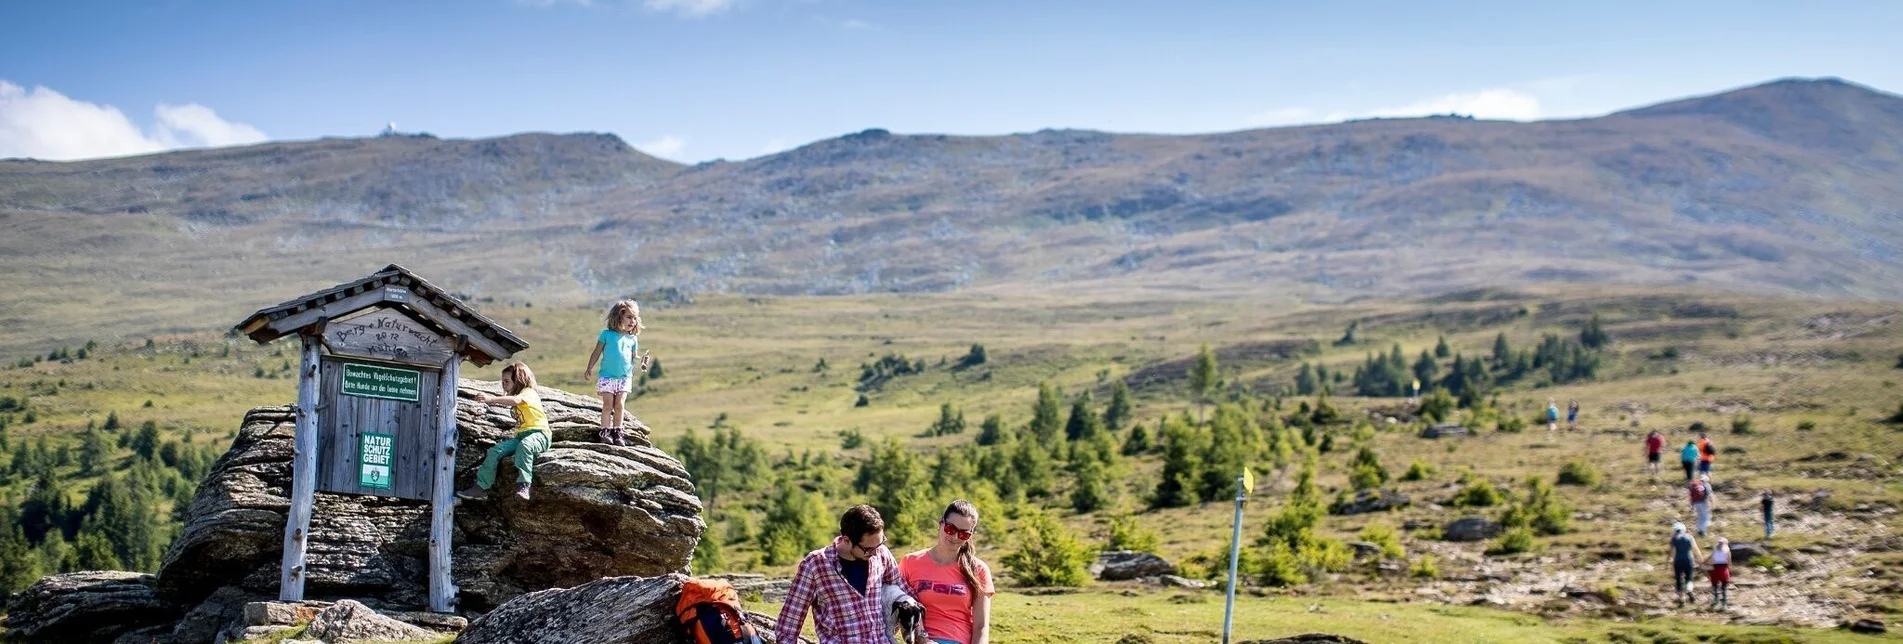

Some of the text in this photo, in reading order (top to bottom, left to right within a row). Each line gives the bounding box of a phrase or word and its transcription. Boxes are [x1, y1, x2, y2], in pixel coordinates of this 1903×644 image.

[337, 325, 365, 342] Berg
[377, 317, 438, 346] Naturwacht
[345, 369, 371, 379] Bewachtes
[344, 380, 356, 389] Bitte
[356, 382, 370, 391] Hunde
[399, 387, 417, 395] nehmen
[364, 435, 391, 446] NATUR
[363, 445, 391, 456] SCHUTZ
[363, 454, 390, 465] GEBIET
